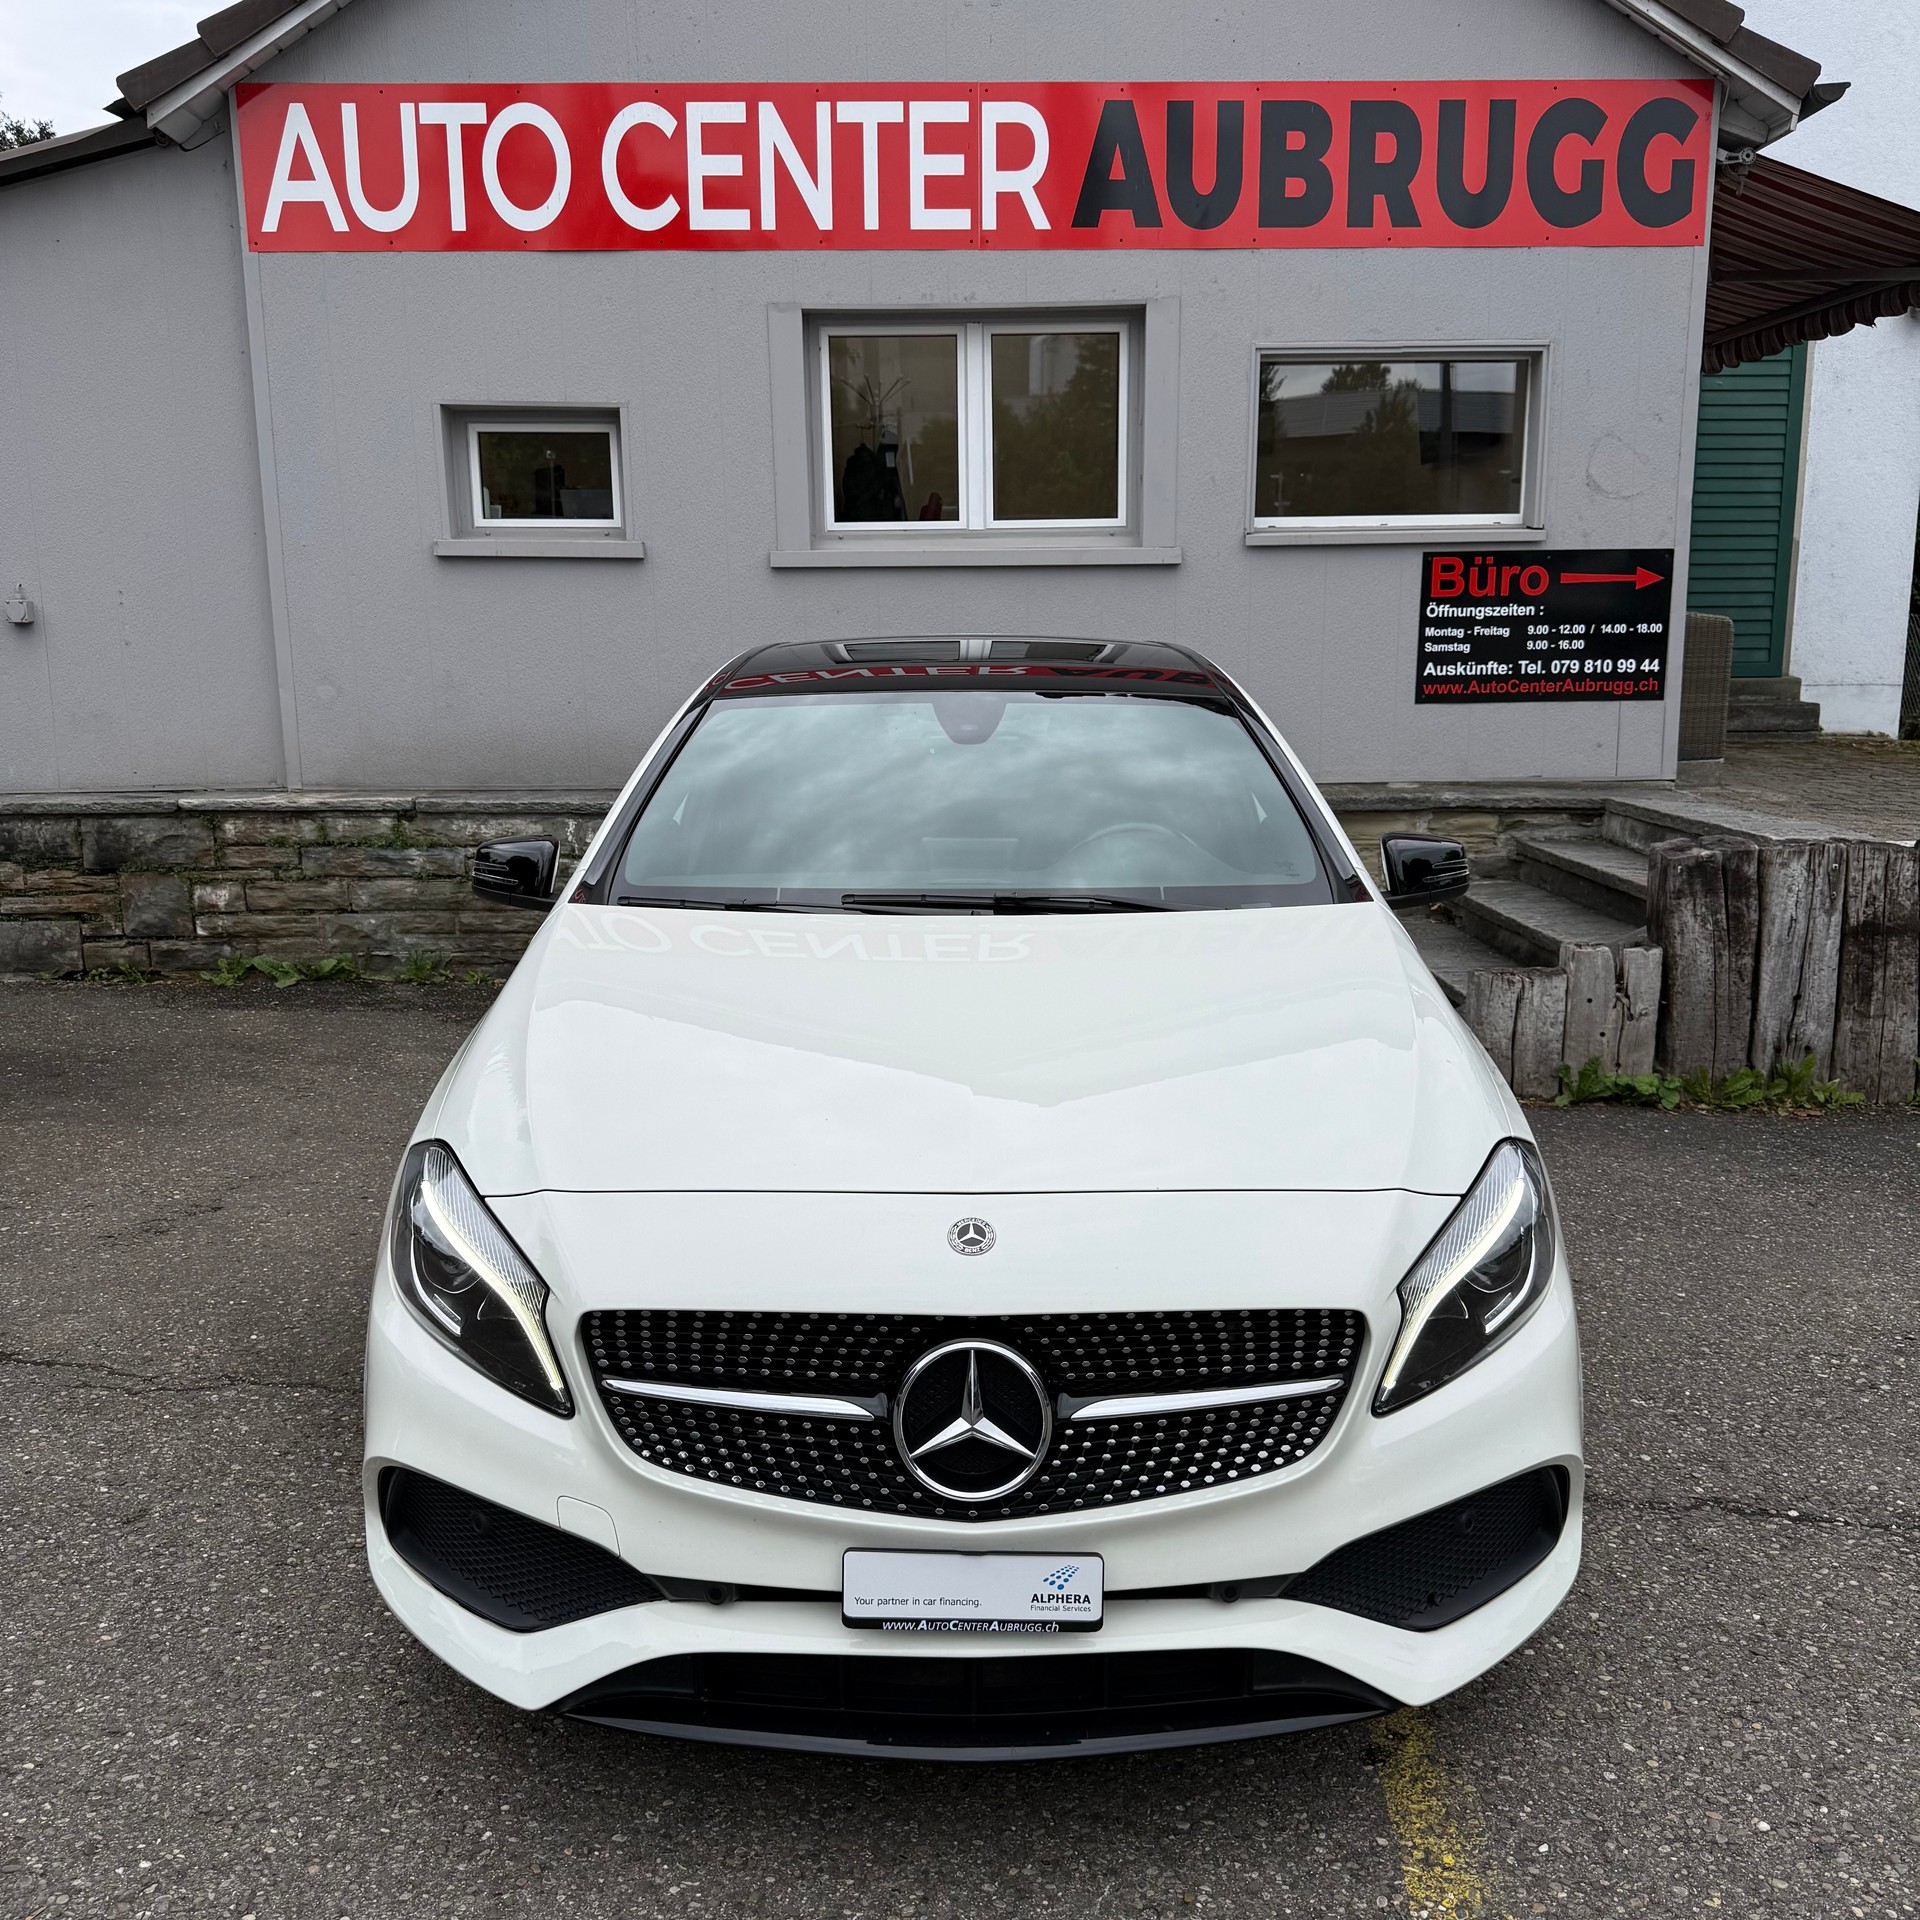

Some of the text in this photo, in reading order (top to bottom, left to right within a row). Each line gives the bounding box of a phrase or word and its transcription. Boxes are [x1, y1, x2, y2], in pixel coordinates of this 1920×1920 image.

[261, 97, 1700, 233] AUTO CENTER AUBRUGG
[1430, 556, 1549, 597] Büro
[1426, 602, 1535, 620] Öffnungszeiten
[1425, 626, 1464, 638] Montag
[1474, 625, 1510, 637] Freitag
[1527, 624, 1549, 635] 9.00
[1558, 624, 1586, 634] 12.00
[1600, 624, 1627, 634] 14.00
[1636, 623, 1663, 633] 18.00
[1424, 642, 1471, 653] Samstag
[1526, 640, 1548, 650] 9.00
[1557, 640, 1585, 650] 16.00
[1423, 659, 1660, 676] Auskünfte: Tel. 079 810 99 44
[1423, 678, 1659, 696] www.AutoCenterAubrugg.ch
[854, 1596, 875, 1606] Your
[877, 1597, 909, 1608] partner
[912, 1597, 920, 1606] in
[939, 1597, 983, 1608] financing.
[1031, 1593, 1091, 1604] ALPHERA
